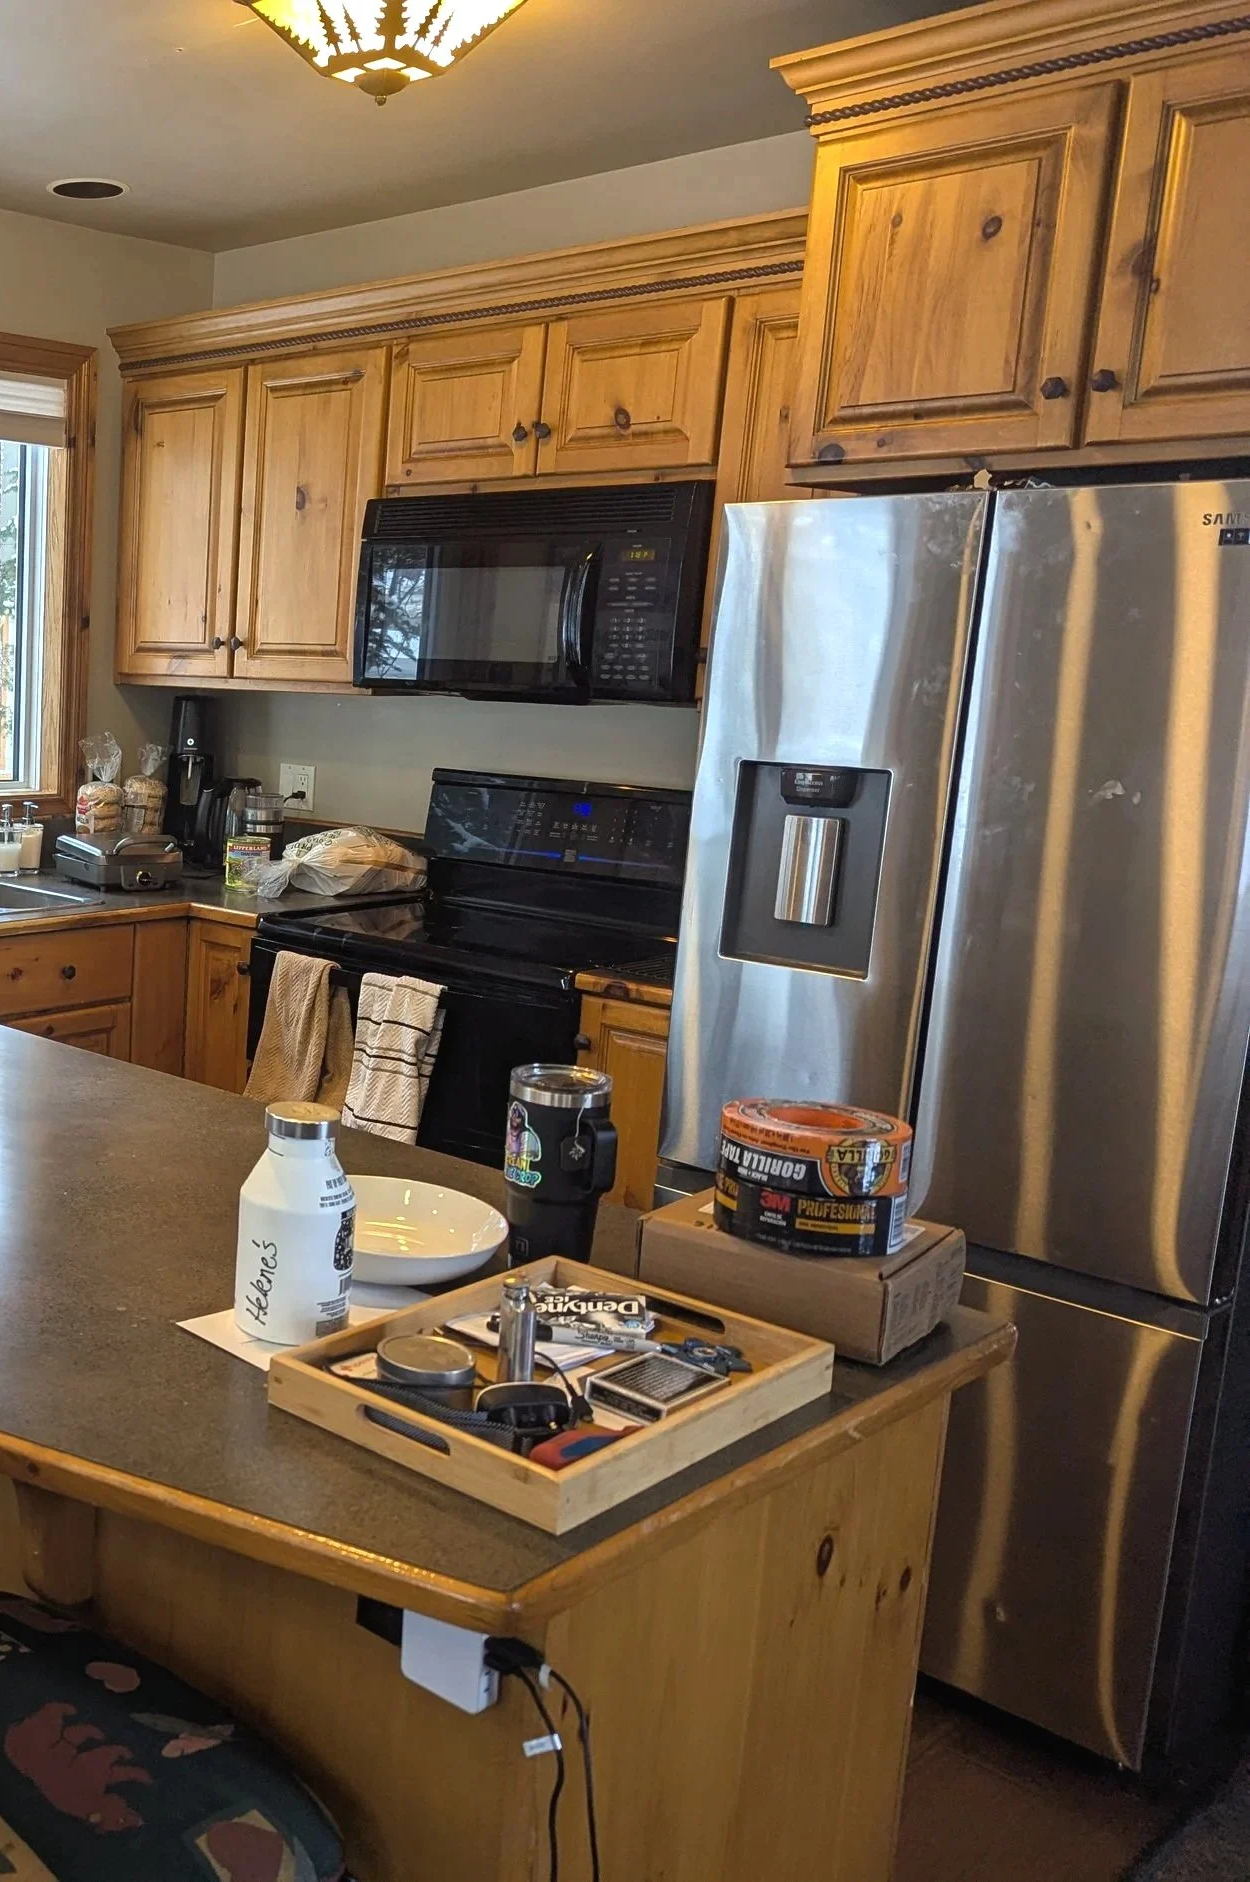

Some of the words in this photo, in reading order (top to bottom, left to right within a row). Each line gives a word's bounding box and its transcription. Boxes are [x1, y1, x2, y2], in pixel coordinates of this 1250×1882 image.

[721, 1139, 741, 1164] TAPE
[742, 1151, 806, 1181] GORILLA
[760, 1190, 791, 1212] 3M
[534, 1298, 639, 1315] Dentyne
